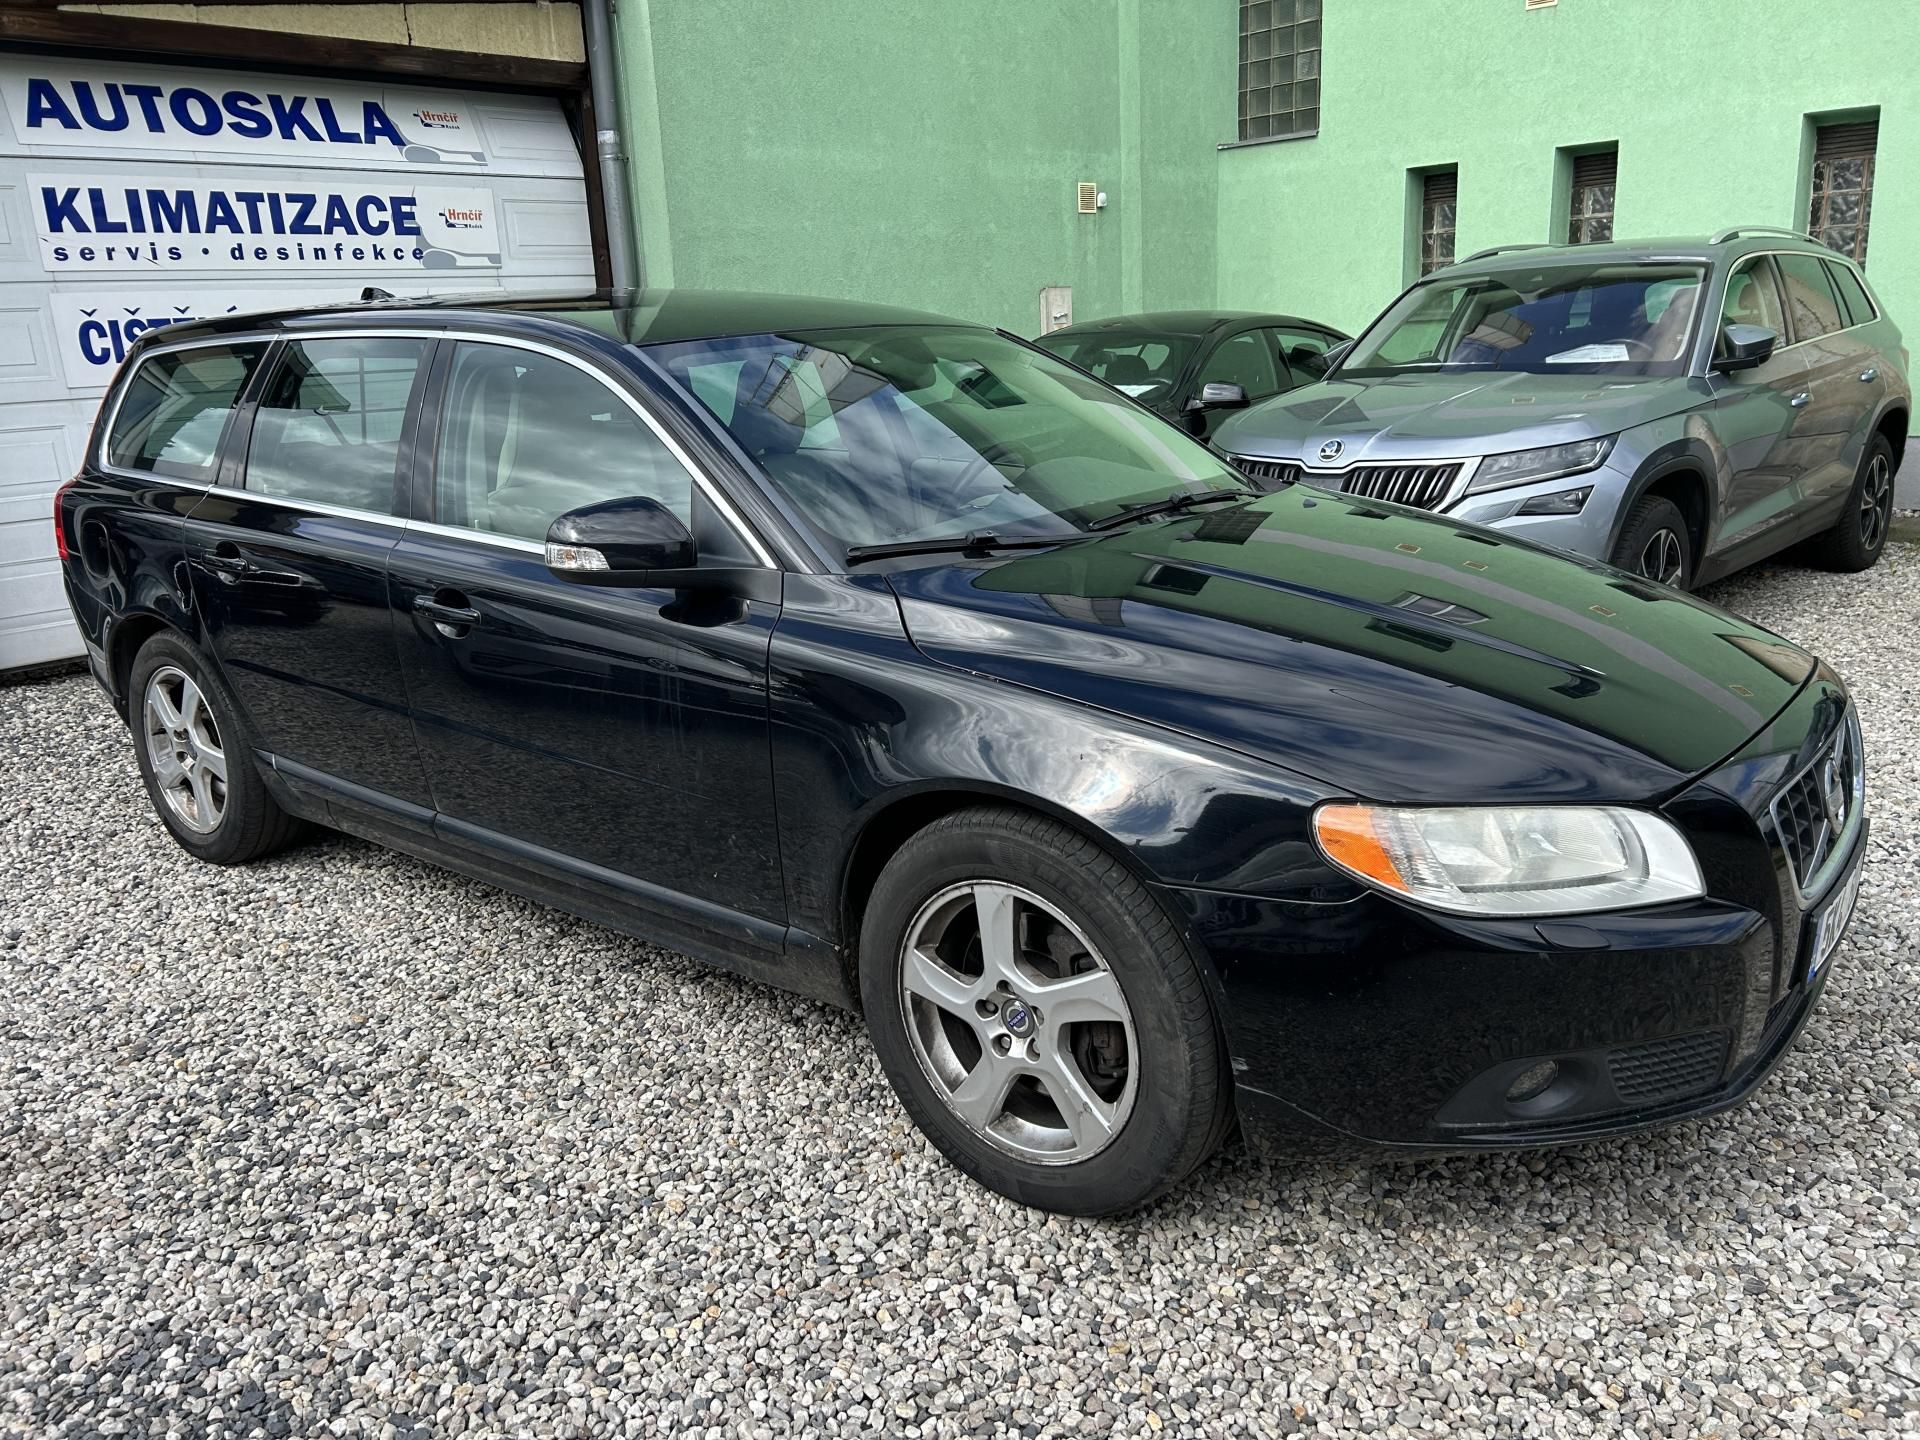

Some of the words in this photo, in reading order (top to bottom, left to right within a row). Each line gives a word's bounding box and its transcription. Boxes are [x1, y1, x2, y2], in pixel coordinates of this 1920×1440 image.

[26, 78, 407, 147] AUTOSKLA
[422, 110, 459, 123] Hrnčíř
[41, 186, 421, 236] KLIMATIZACE
[447, 208, 483, 221] Hrnčíř
[53, 243, 182, 262] servis
[230, 242, 425, 262] desinfekce
